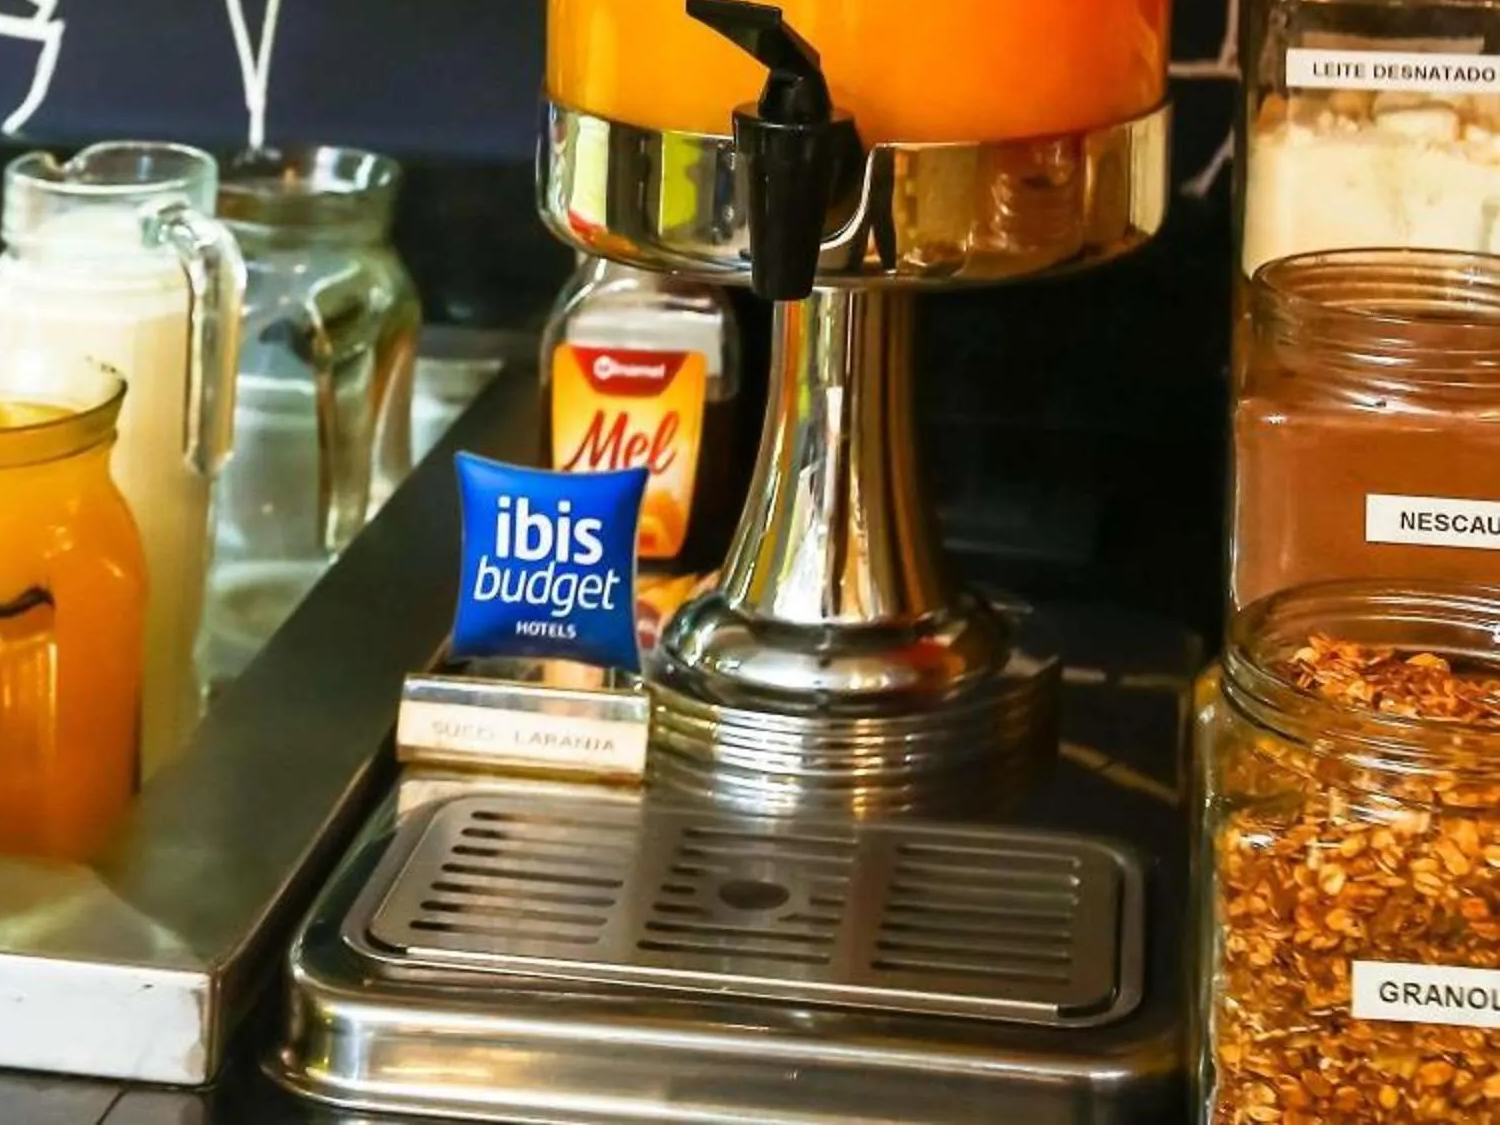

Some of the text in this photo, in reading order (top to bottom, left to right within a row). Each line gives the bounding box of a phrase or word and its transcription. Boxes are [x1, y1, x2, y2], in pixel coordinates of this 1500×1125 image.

[1312, 61, 1496, 83] LEITE DESNATADO
[562, 408, 680, 476] Mel
[495, 495, 604, 565] ibis
[1399, 511, 1500, 536] NESCAU
[473, 555, 621, 617] budget
[516, 620, 577, 640] HOTELS
